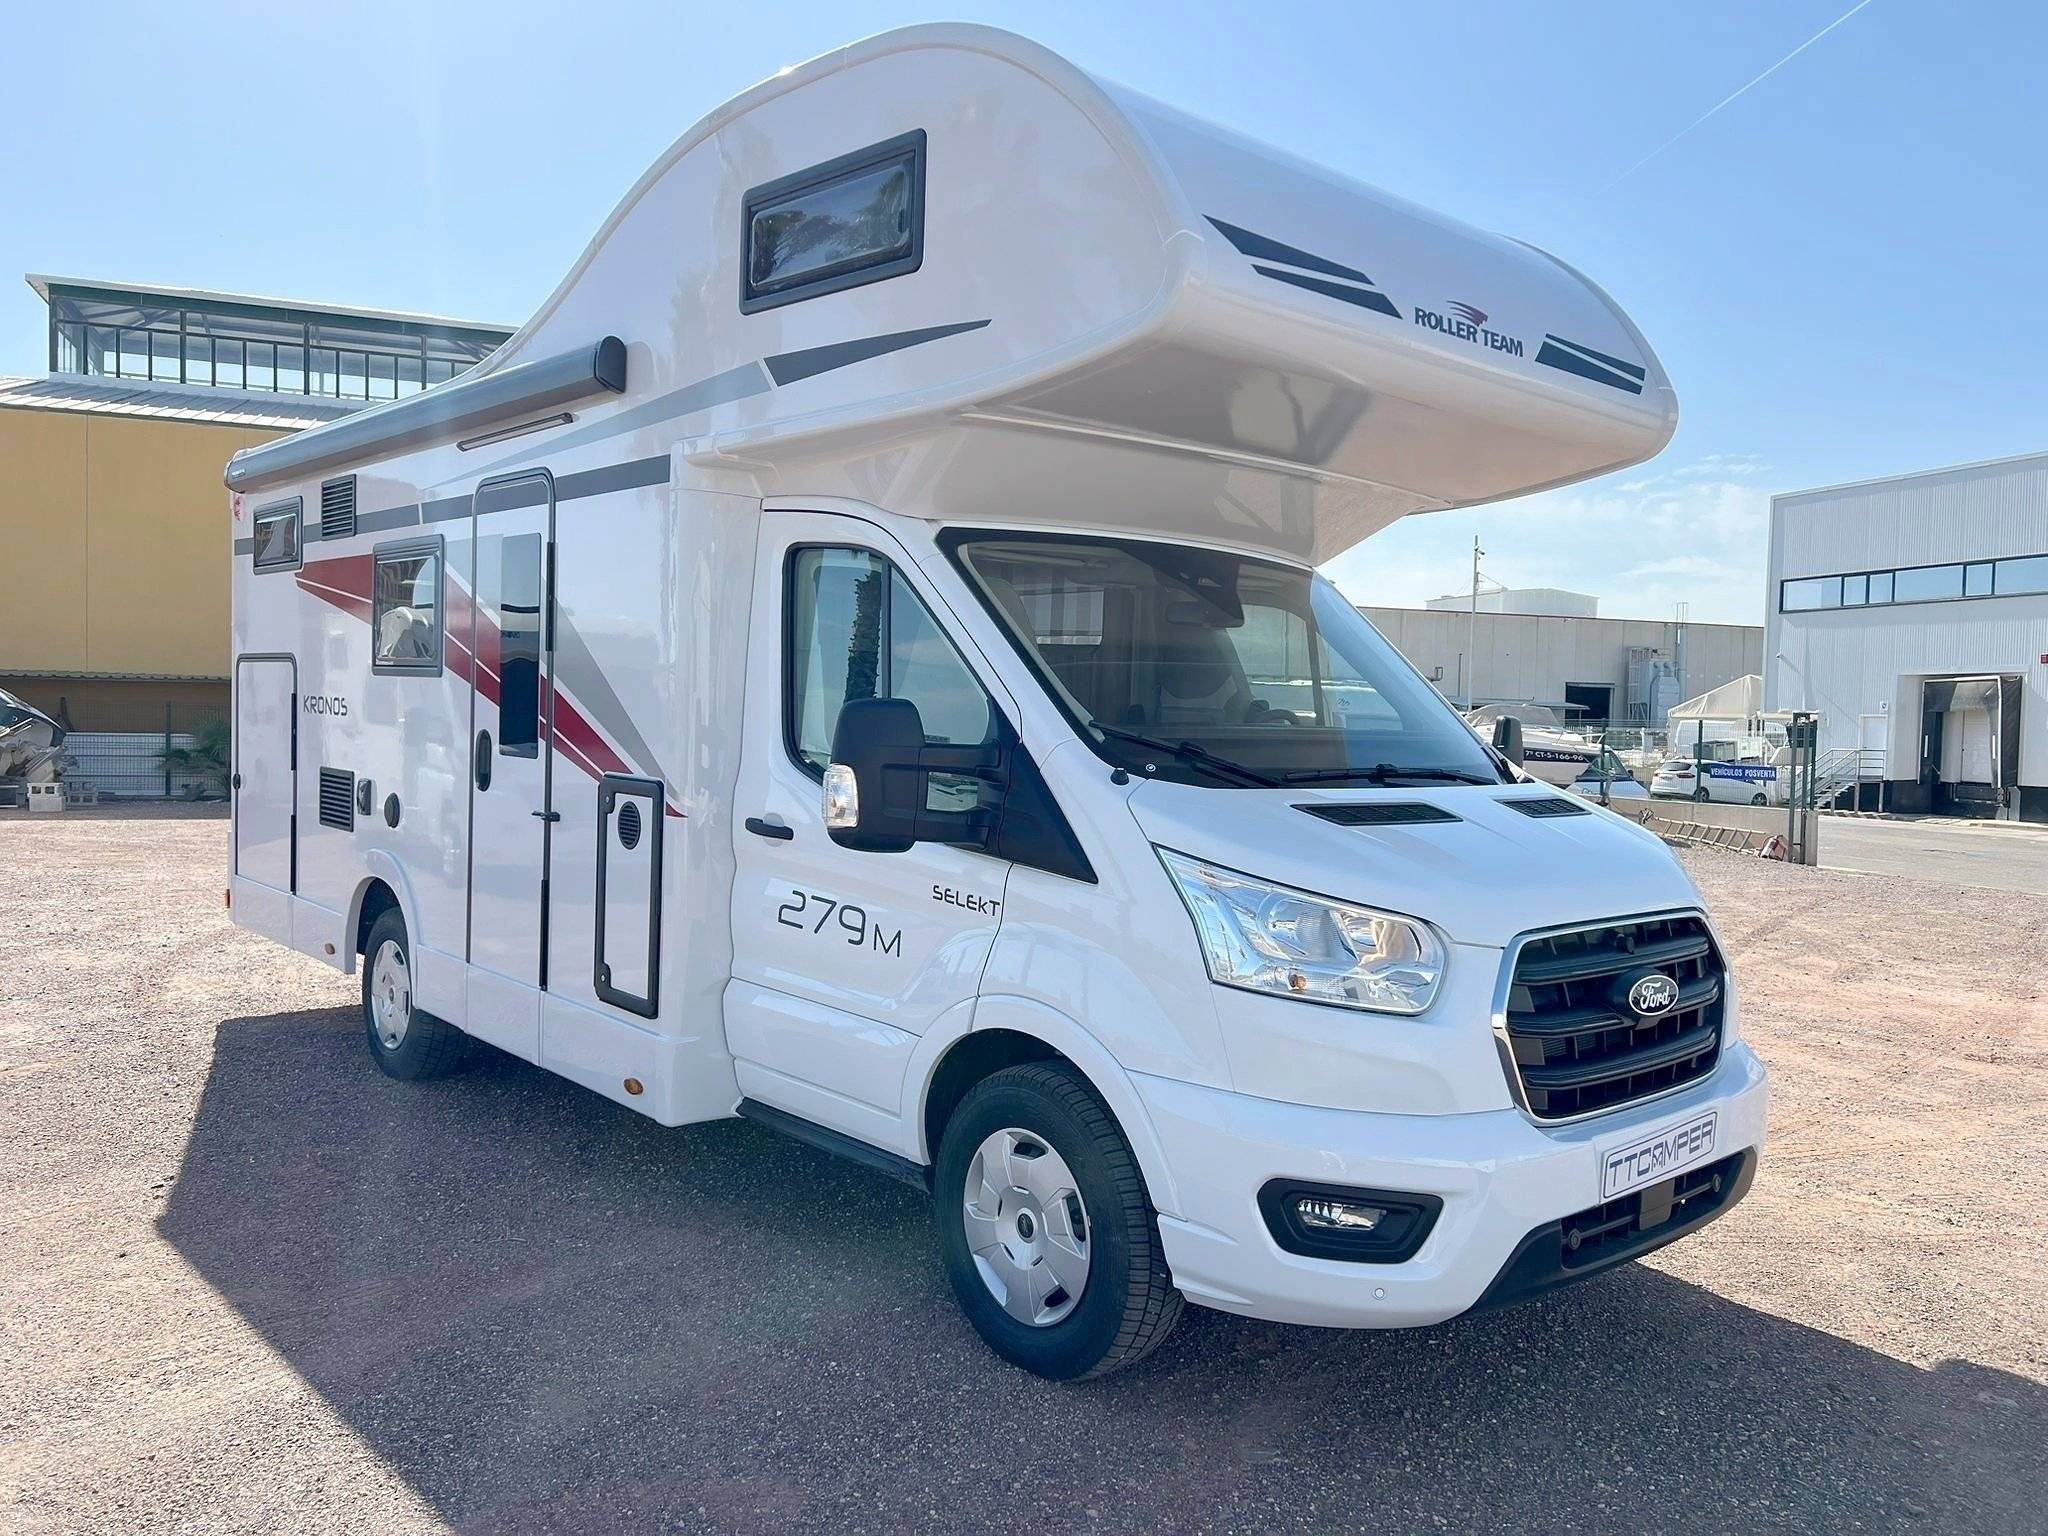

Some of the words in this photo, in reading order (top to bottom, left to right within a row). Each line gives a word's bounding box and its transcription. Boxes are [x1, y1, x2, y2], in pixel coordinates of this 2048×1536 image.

[1414, 306, 1478, 343] ROLLER
[1480, 328, 1524, 357] TEAM
[303, 695, 348, 716] KRONOS
[1744, 769, 1776, 778] POSVENTA
[932, 884, 1001, 917] SELEKT
[1640, 981, 1671, 1010] Ford
[1609, 1119, 1714, 1188] TTCAMPER
